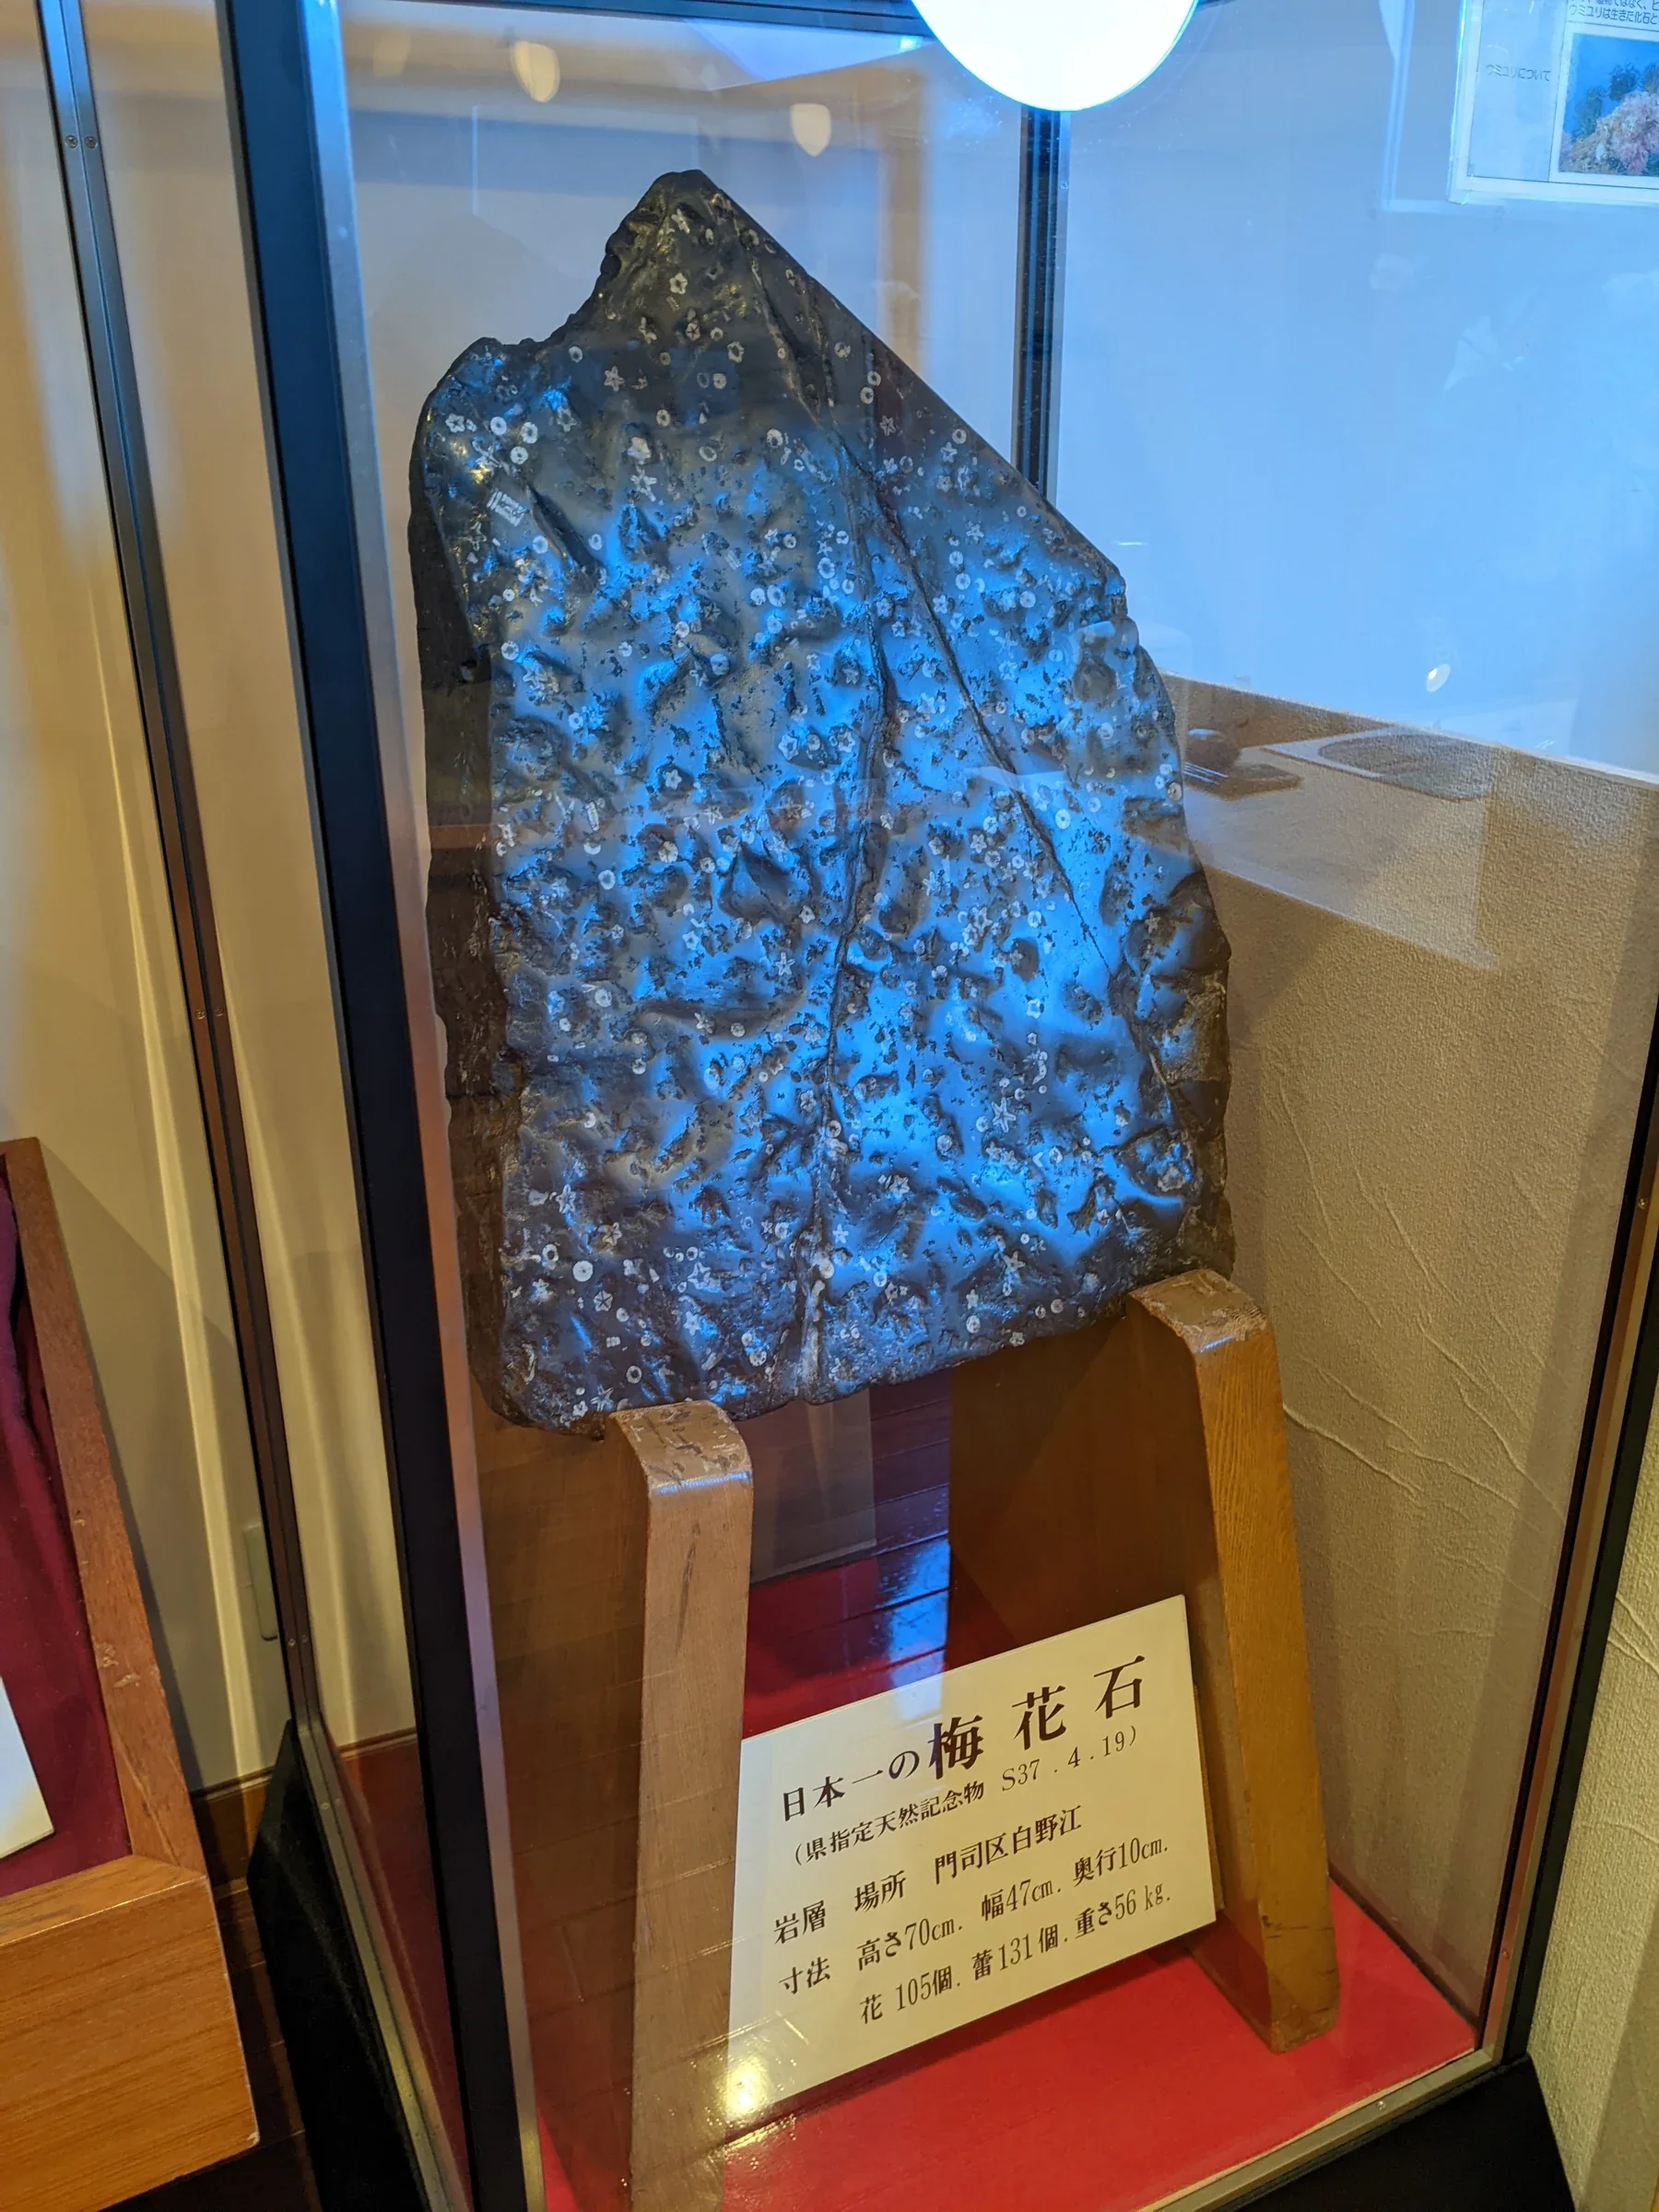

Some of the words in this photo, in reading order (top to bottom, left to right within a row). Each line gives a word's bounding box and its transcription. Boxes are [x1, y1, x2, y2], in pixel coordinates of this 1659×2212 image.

[773, 1899, 827, 1945] 岩層
[853, 1869, 907, 1913] 場所
[934, 1805, 1082, 1885] 門司区白野江
[778, 1956, 831, 1995] 寸法
